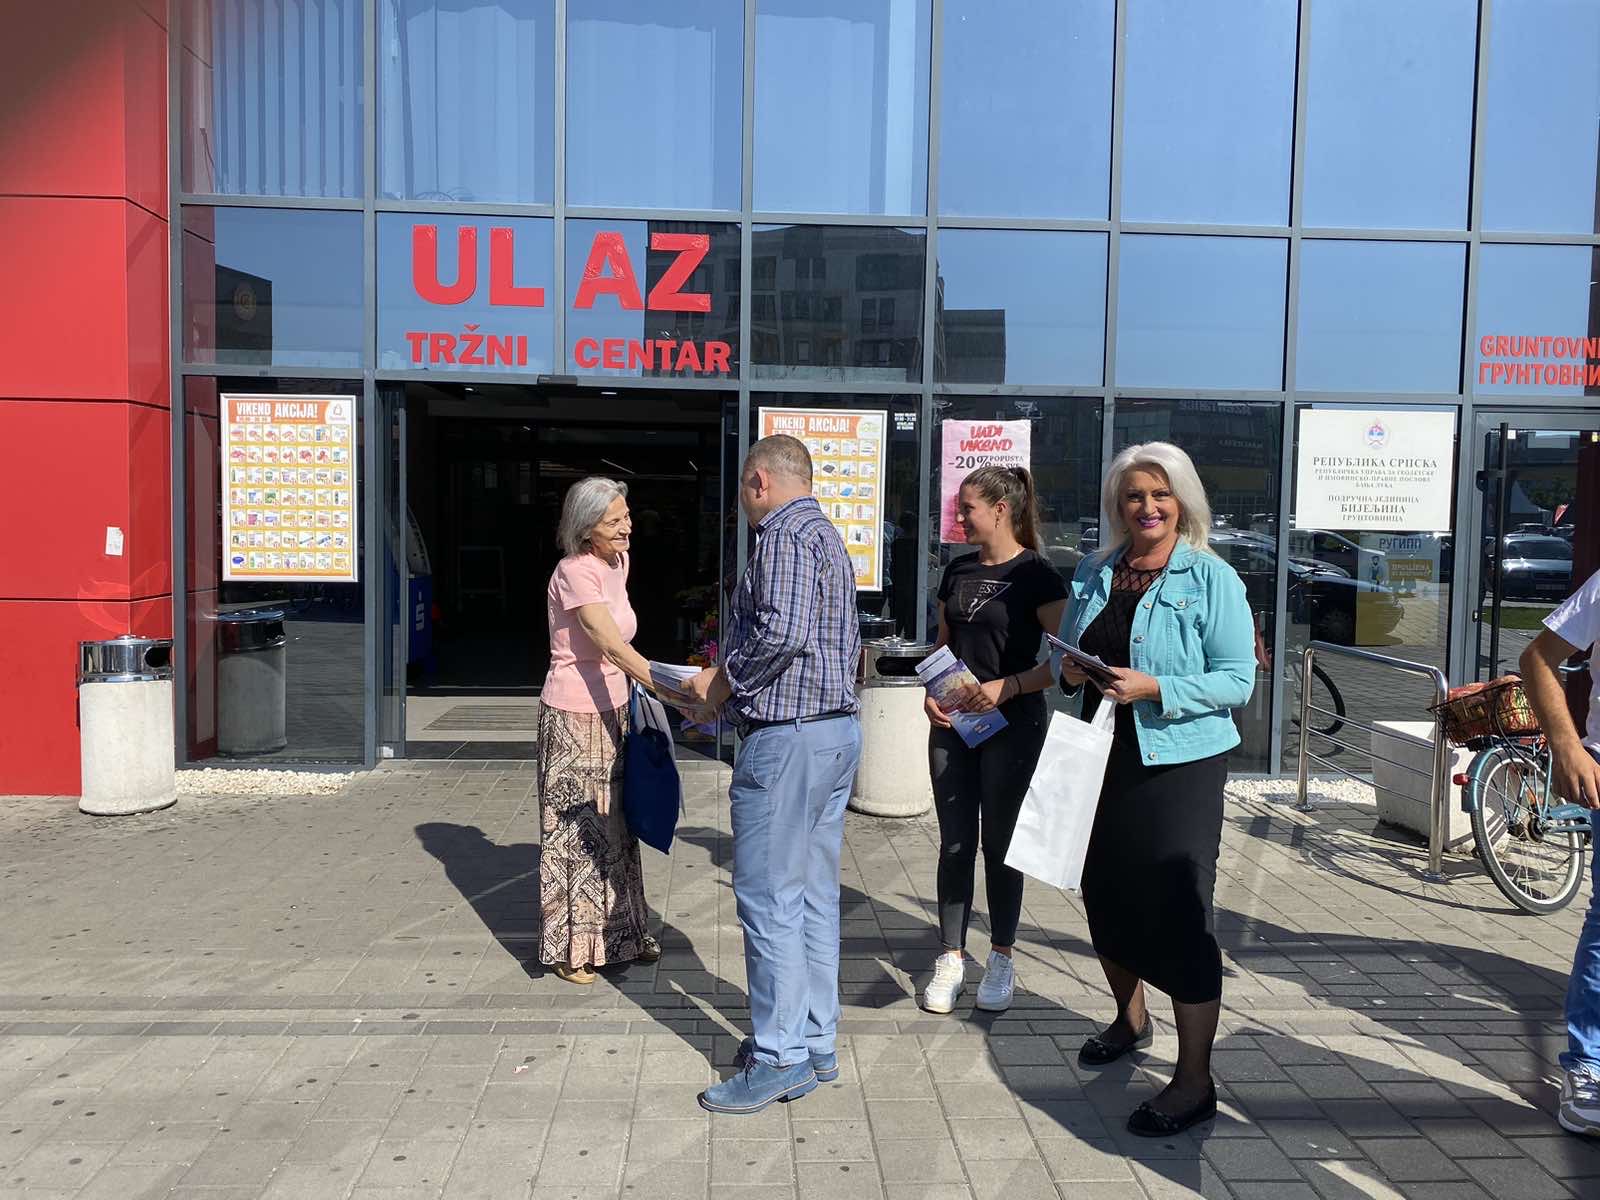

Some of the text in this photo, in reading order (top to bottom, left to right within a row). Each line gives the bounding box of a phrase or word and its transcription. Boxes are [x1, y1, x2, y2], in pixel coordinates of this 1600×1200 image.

[406, 324, 732, 373] TRŽNI CENTAR
[236, 402, 318, 419] VIKEND AKCIJA!
[772, 415, 850, 433] VIKEND AKCIJA!
[960, 439, 1013, 452] VIKEND
[948, 455, 992, 469] -20%
[1313, 456, 1438, 469] РЕПУБЛИКА СРПСКА
[1341, 503, 1406, 514] БИЈЕЉИНА
